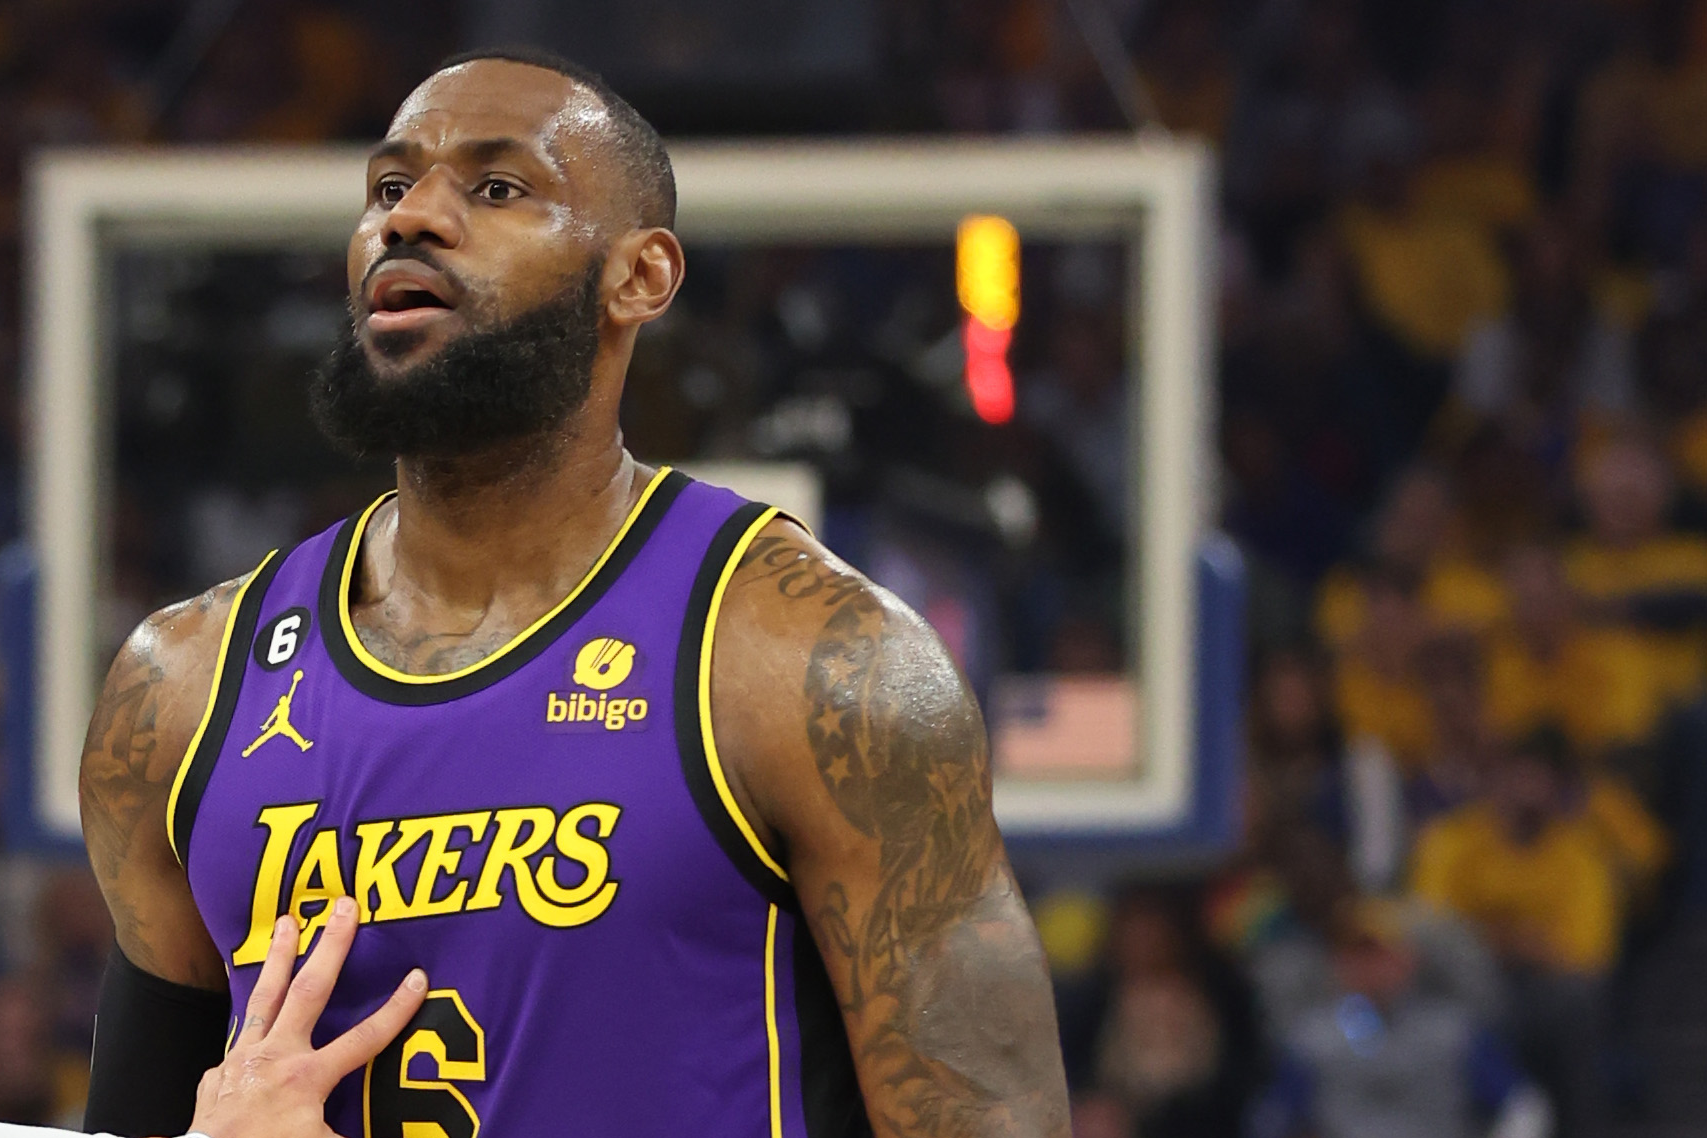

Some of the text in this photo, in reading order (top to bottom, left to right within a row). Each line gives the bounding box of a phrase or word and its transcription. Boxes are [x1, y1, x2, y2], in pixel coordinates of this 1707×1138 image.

[266, 613, 302, 665] 6
[546, 692, 649, 731] bibigo
[232, 800, 623, 967] LAKERS
